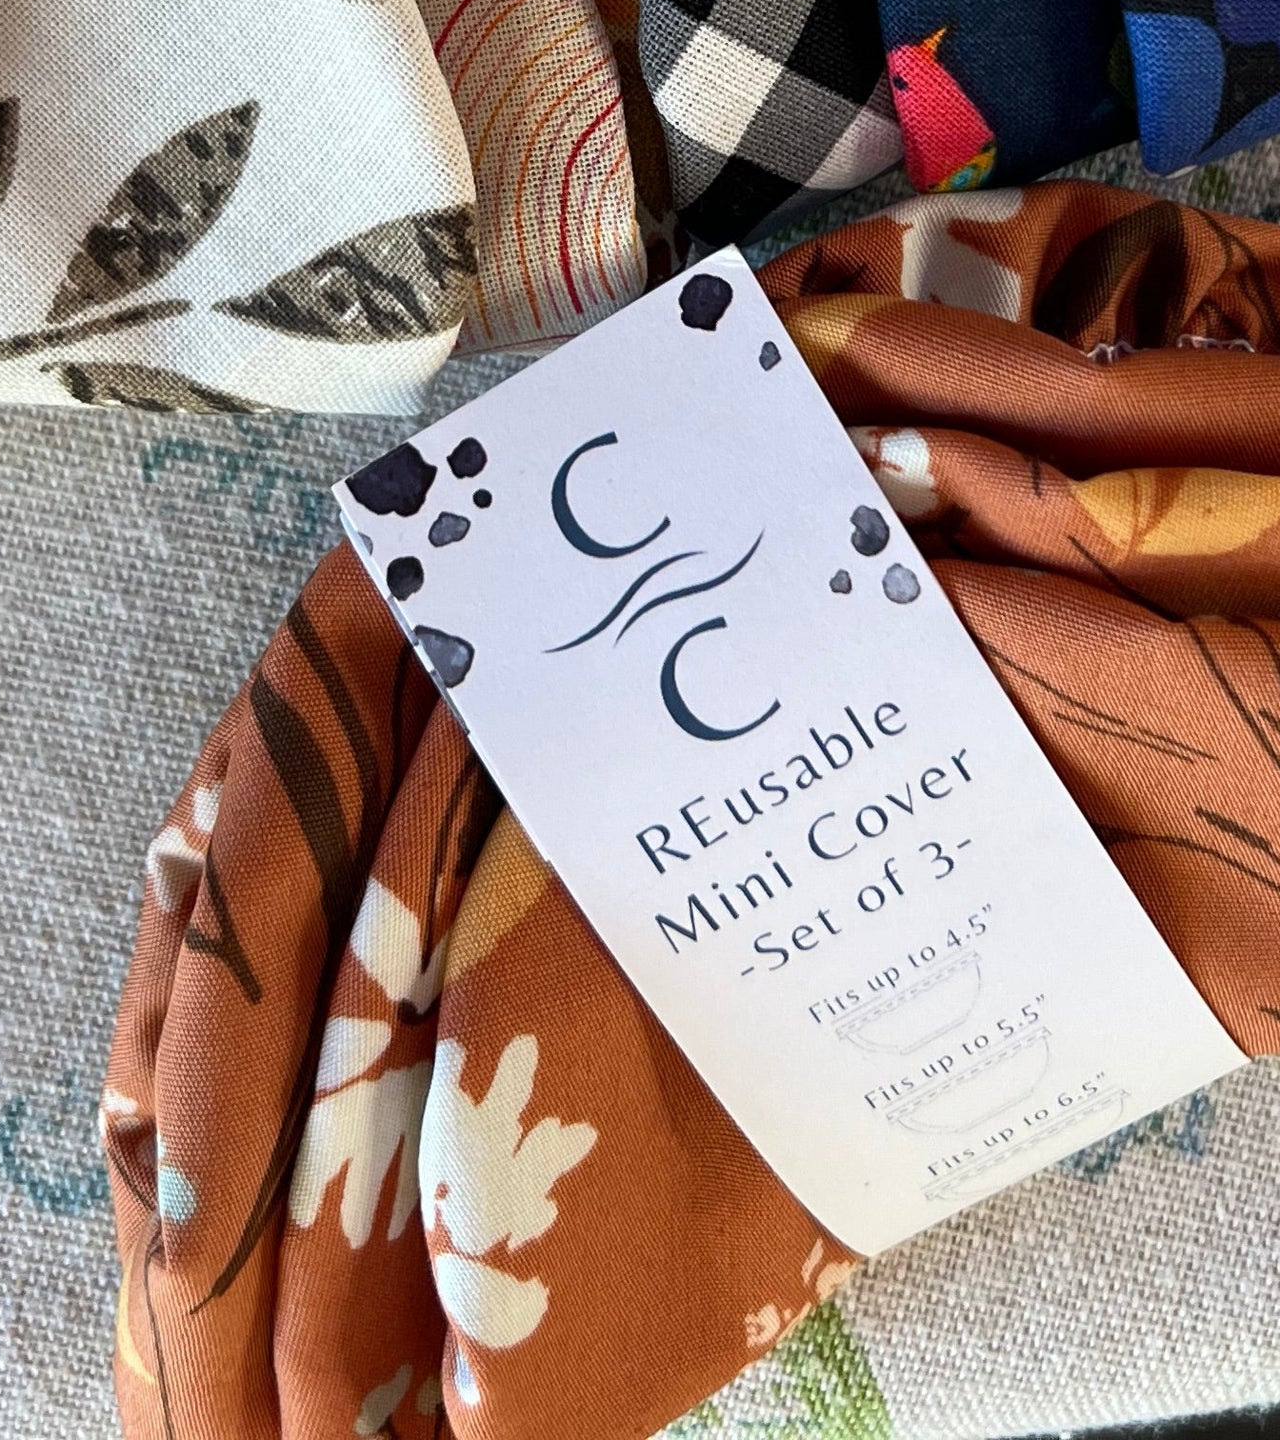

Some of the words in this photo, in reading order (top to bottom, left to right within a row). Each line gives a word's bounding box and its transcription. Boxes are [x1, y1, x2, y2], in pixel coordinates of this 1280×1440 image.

[551, 431, 670, 558] C
[660, 616, 781, 741] C
[637, 701, 907, 874] REusable
[655, 850, 793, 955] Mini
[807, 747, 974, 860] Cover
[740, 907, 841, 978] -Set
[857, 858, 905, 914] of
[918, 838, 972, 879] 3-
[808, 988, 859, 1024] Fits
[867, 963, 901, 994] up
[908, 944, 936, 968] to
[864, 1076, 915, 1110] Fits
[921, 1052, 954, 1083] up
[961, 1033, 990, 1056] to
[927, 1147, 976, 1177] Fits
[984, 1124, 1015, 1149] up
[1023, 1108, 1049, 1127] to
